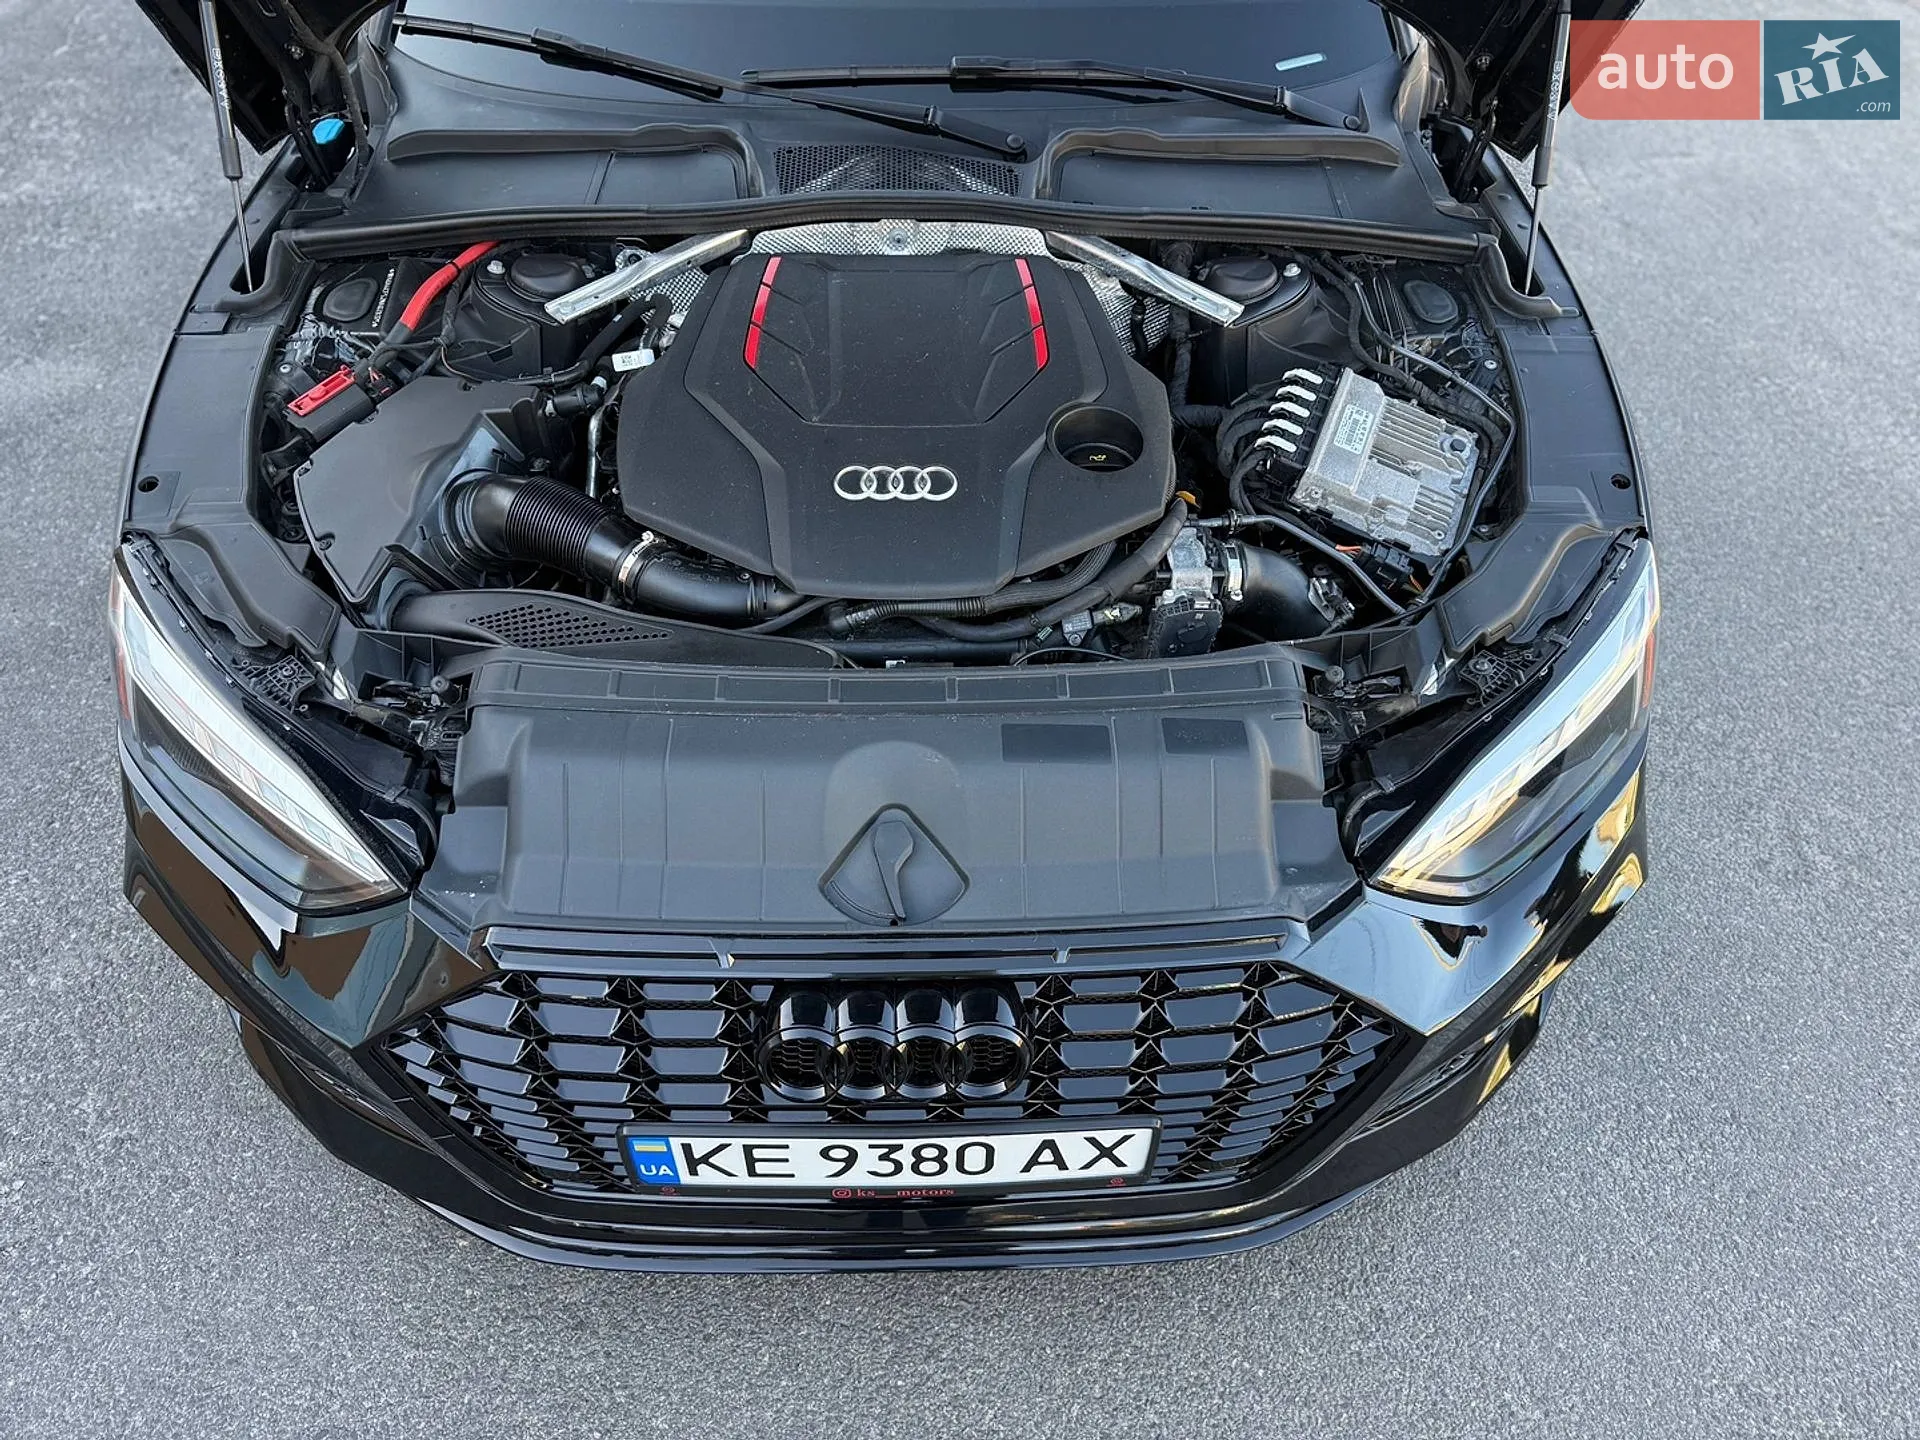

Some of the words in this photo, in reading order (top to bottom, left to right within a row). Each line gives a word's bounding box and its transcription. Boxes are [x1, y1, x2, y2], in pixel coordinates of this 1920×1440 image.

[680, 1142, 796, 1178] KE
[819, 1141, 996, 1178] 9380
[1019, 1133, 1136, 1174] AX
[639, 1164, 675, 1177] UA
